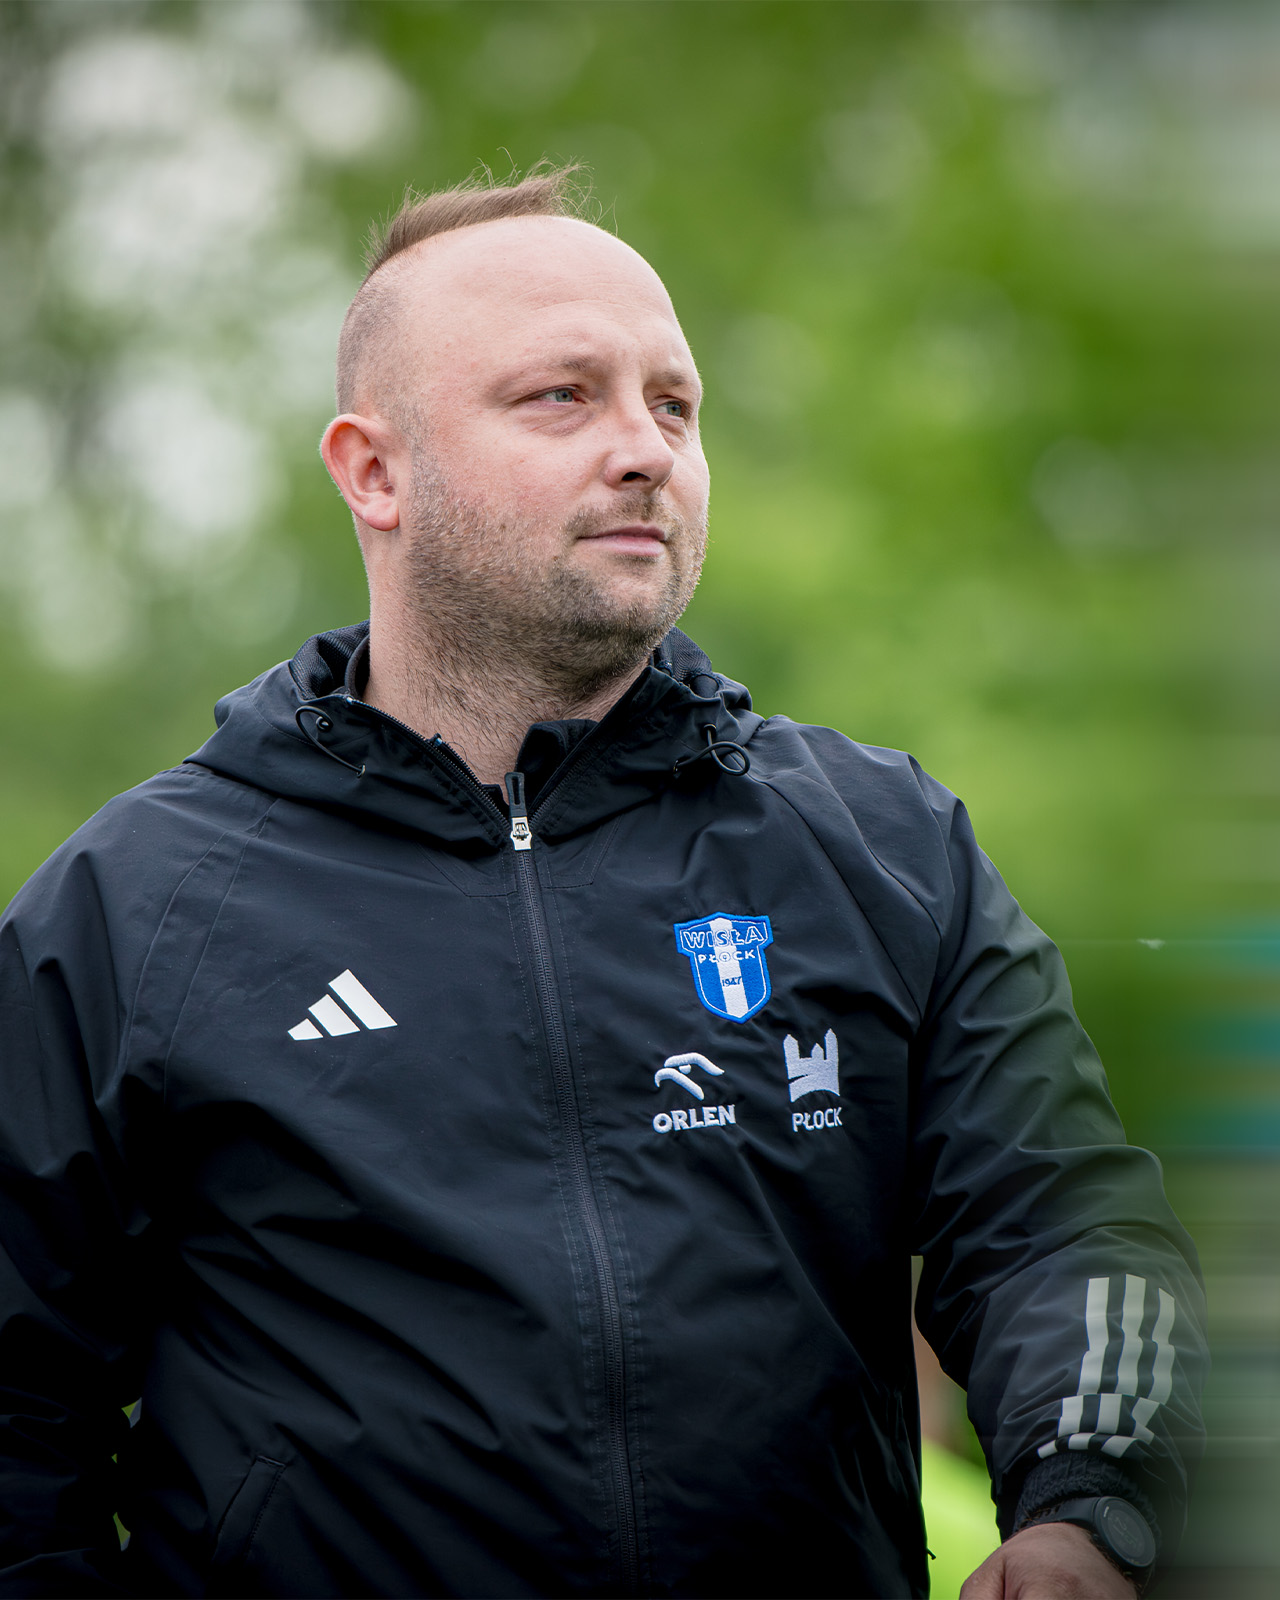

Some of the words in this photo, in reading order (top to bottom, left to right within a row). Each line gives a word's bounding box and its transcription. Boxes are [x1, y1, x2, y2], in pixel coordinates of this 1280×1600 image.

[683, 926, 764, 949] WISŁA
[698, 949, 756, 963] PŁOCK
[721, 976, 742, 987] 1947
[653, 1104, 736, 1133] ORLEN
[792, 1106, 843, 1132] PŁOCK
